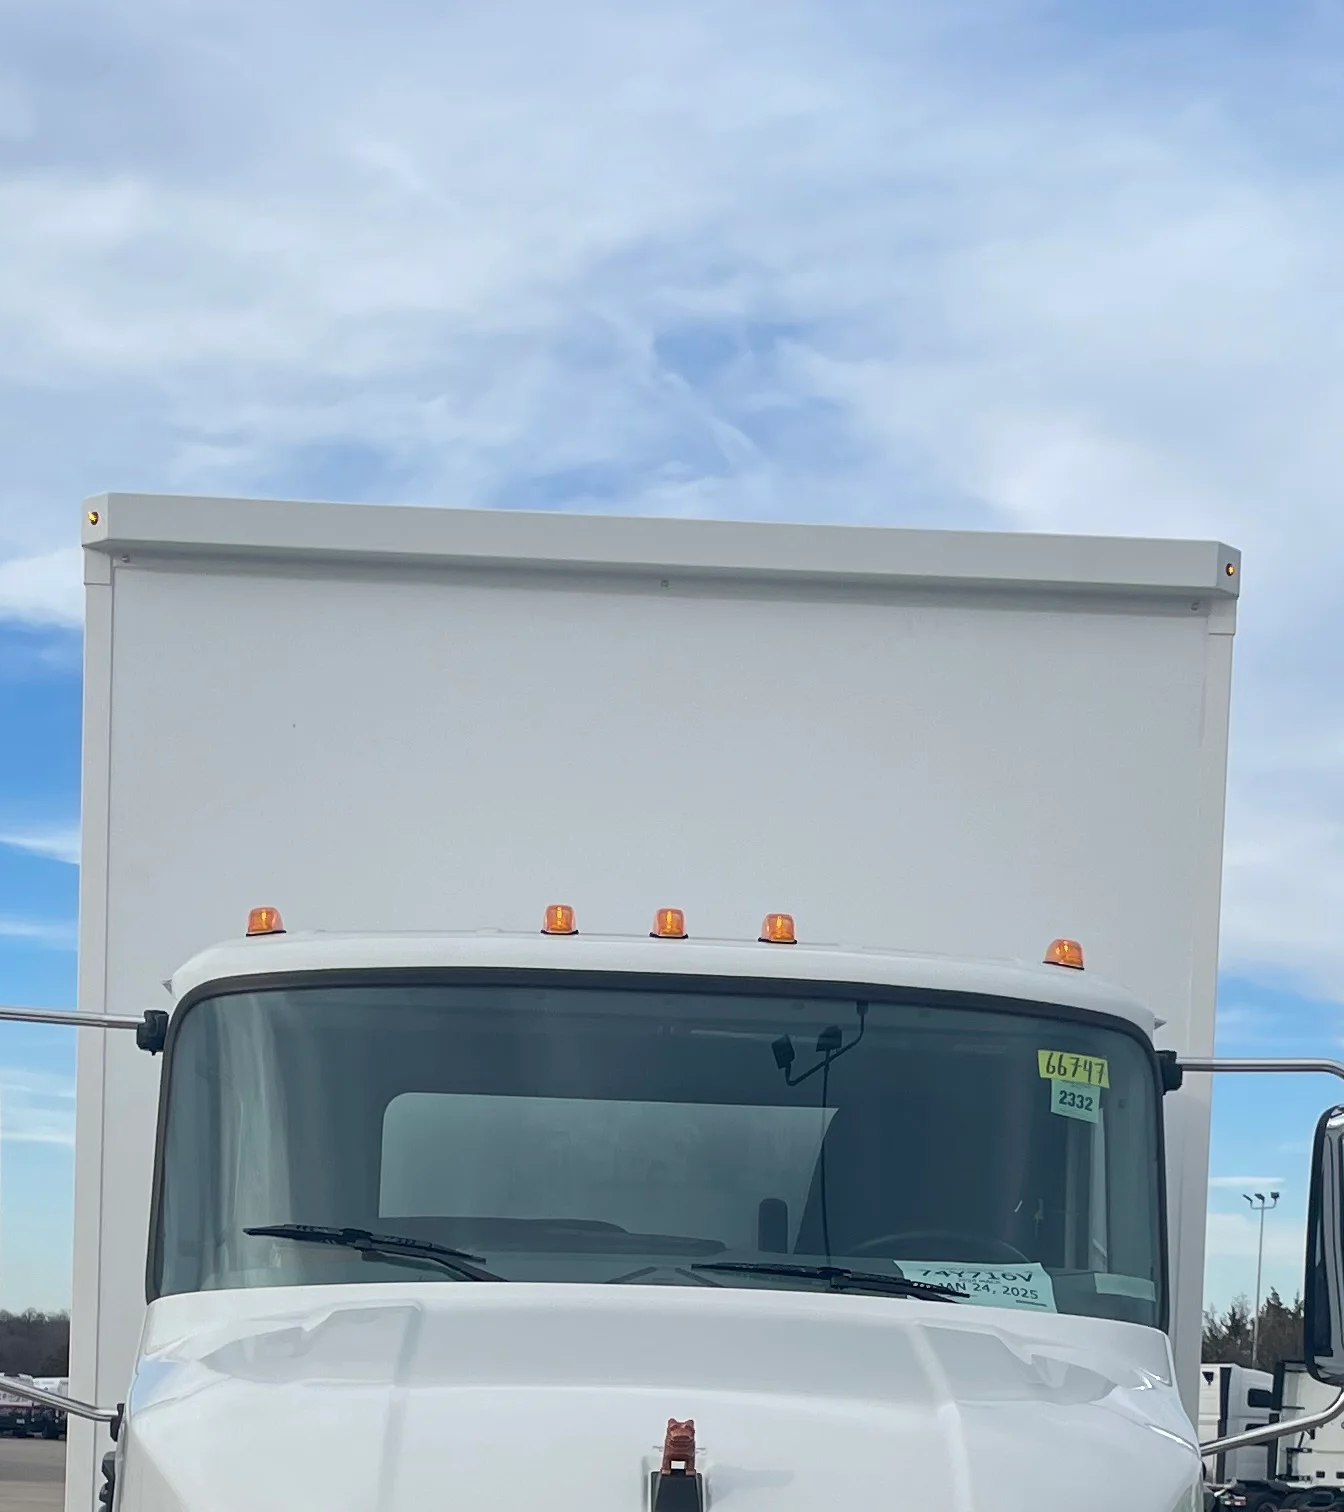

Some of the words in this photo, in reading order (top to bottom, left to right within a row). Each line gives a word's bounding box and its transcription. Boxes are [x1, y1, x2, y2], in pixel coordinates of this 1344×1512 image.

[1046, 1052, 1105, 1084] 66747
[1058, 1090, 1093, 1112] 2332
[972, 1282, 997, 1295] 24,
[1002, 1285, 1039, 1300] 2025
